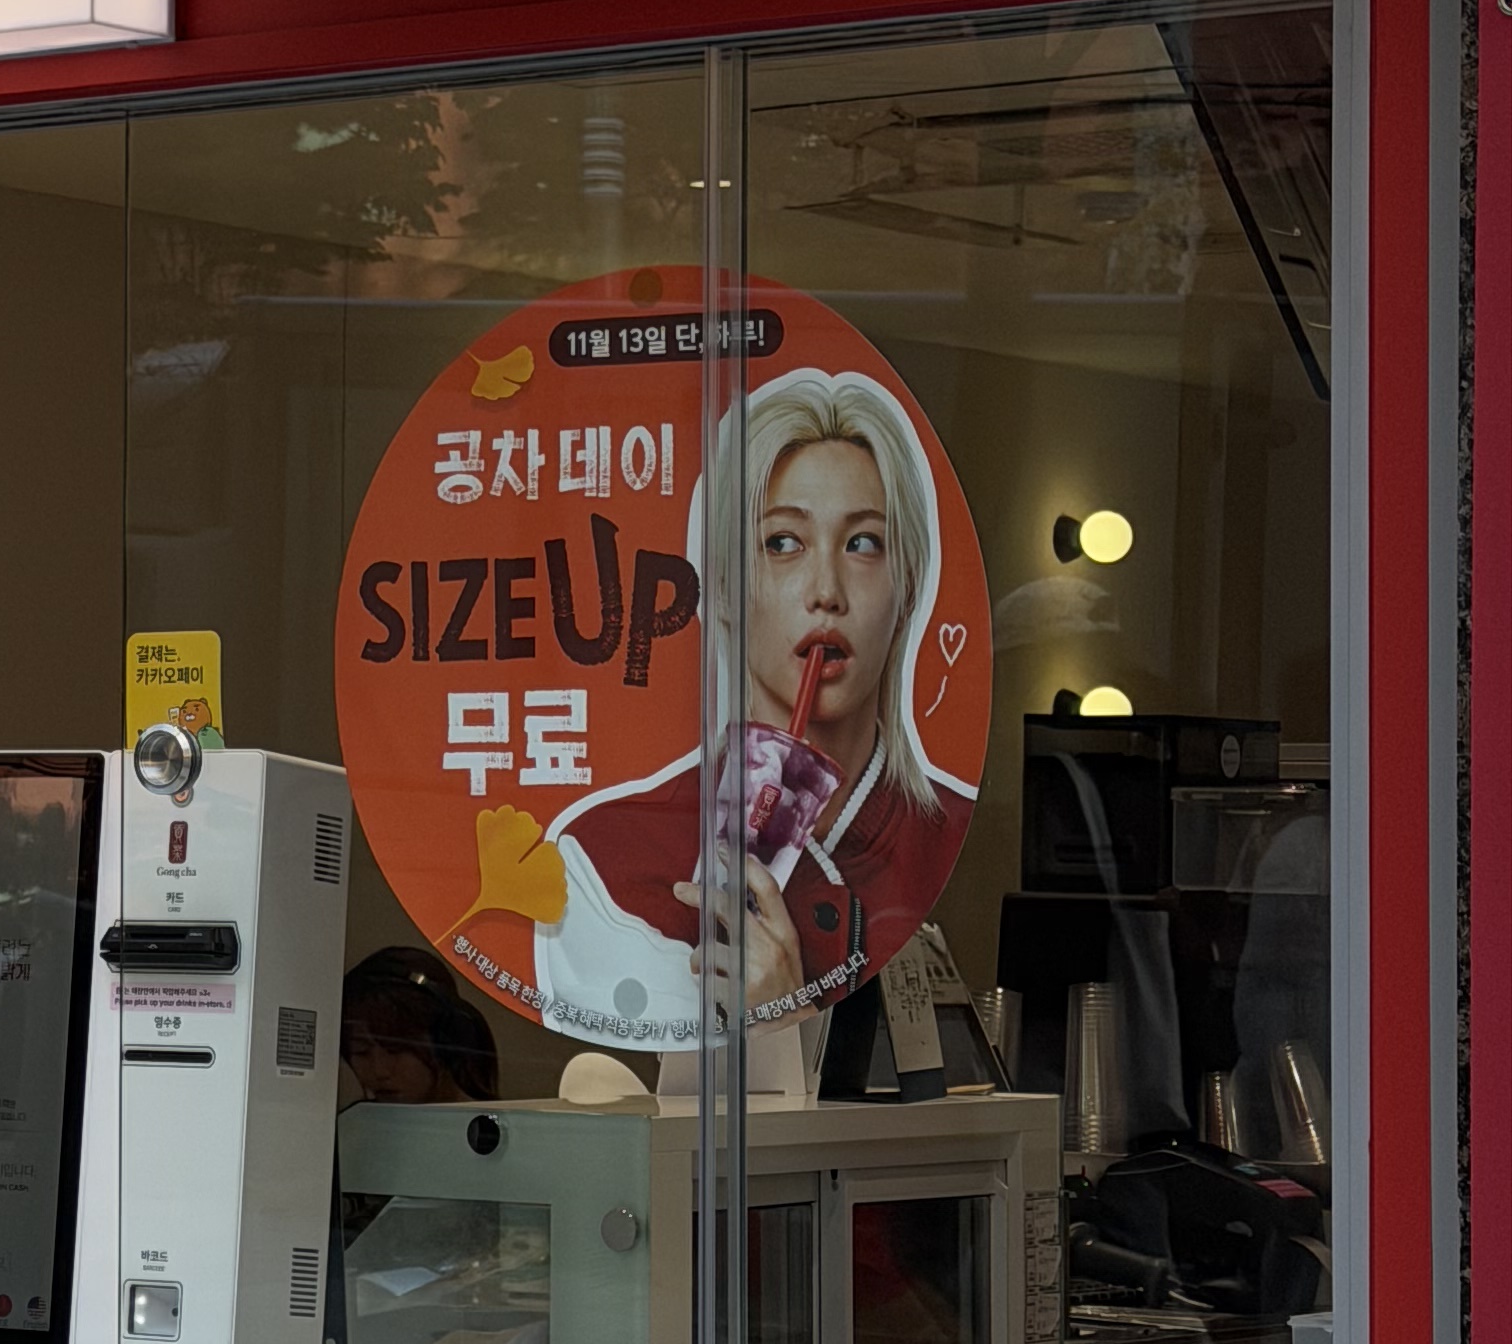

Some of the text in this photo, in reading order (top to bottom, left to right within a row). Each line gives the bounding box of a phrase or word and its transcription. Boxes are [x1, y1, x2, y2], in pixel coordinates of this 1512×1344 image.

[567, 328, 610, 358] 11월
[618, 325, 666, 356] 13일
[360, 513, 701, 687] SIZE UP
[136, 665, 203, 686] 카카오페이
[442, 688, 592, 796] 무료
[157, 866, 197, 879] Gong cha
[165, 891, 184, 904] 카드
[0, 963, 31, 981] 밝게
[134, 997, 148, 1007] pick
[149, 999, 158, 1007] up
[159, 1000, 174, 1008] your
[175, 999, 197, 1008] drinks
[475, 956, 499, 980] 대상
[497, 970, 521, 997] 품목
[520, 985, 544, 1011] 한정
[553, 1001, 578, 1022] 중복
[579, 1008, 604, 1031] 혜택
[605, 1015, 631, 1036] 적용
[632, 1018, 658, 1039] 불가
[670, 1019, 698, 1040] 행사
[755, 993, 796, 1021] 매장에
[795, 982, 823, 1007] 문의
[154, 1016, 182, 1029] 영수증
[141, 1249, 169, 1263] 바코드
